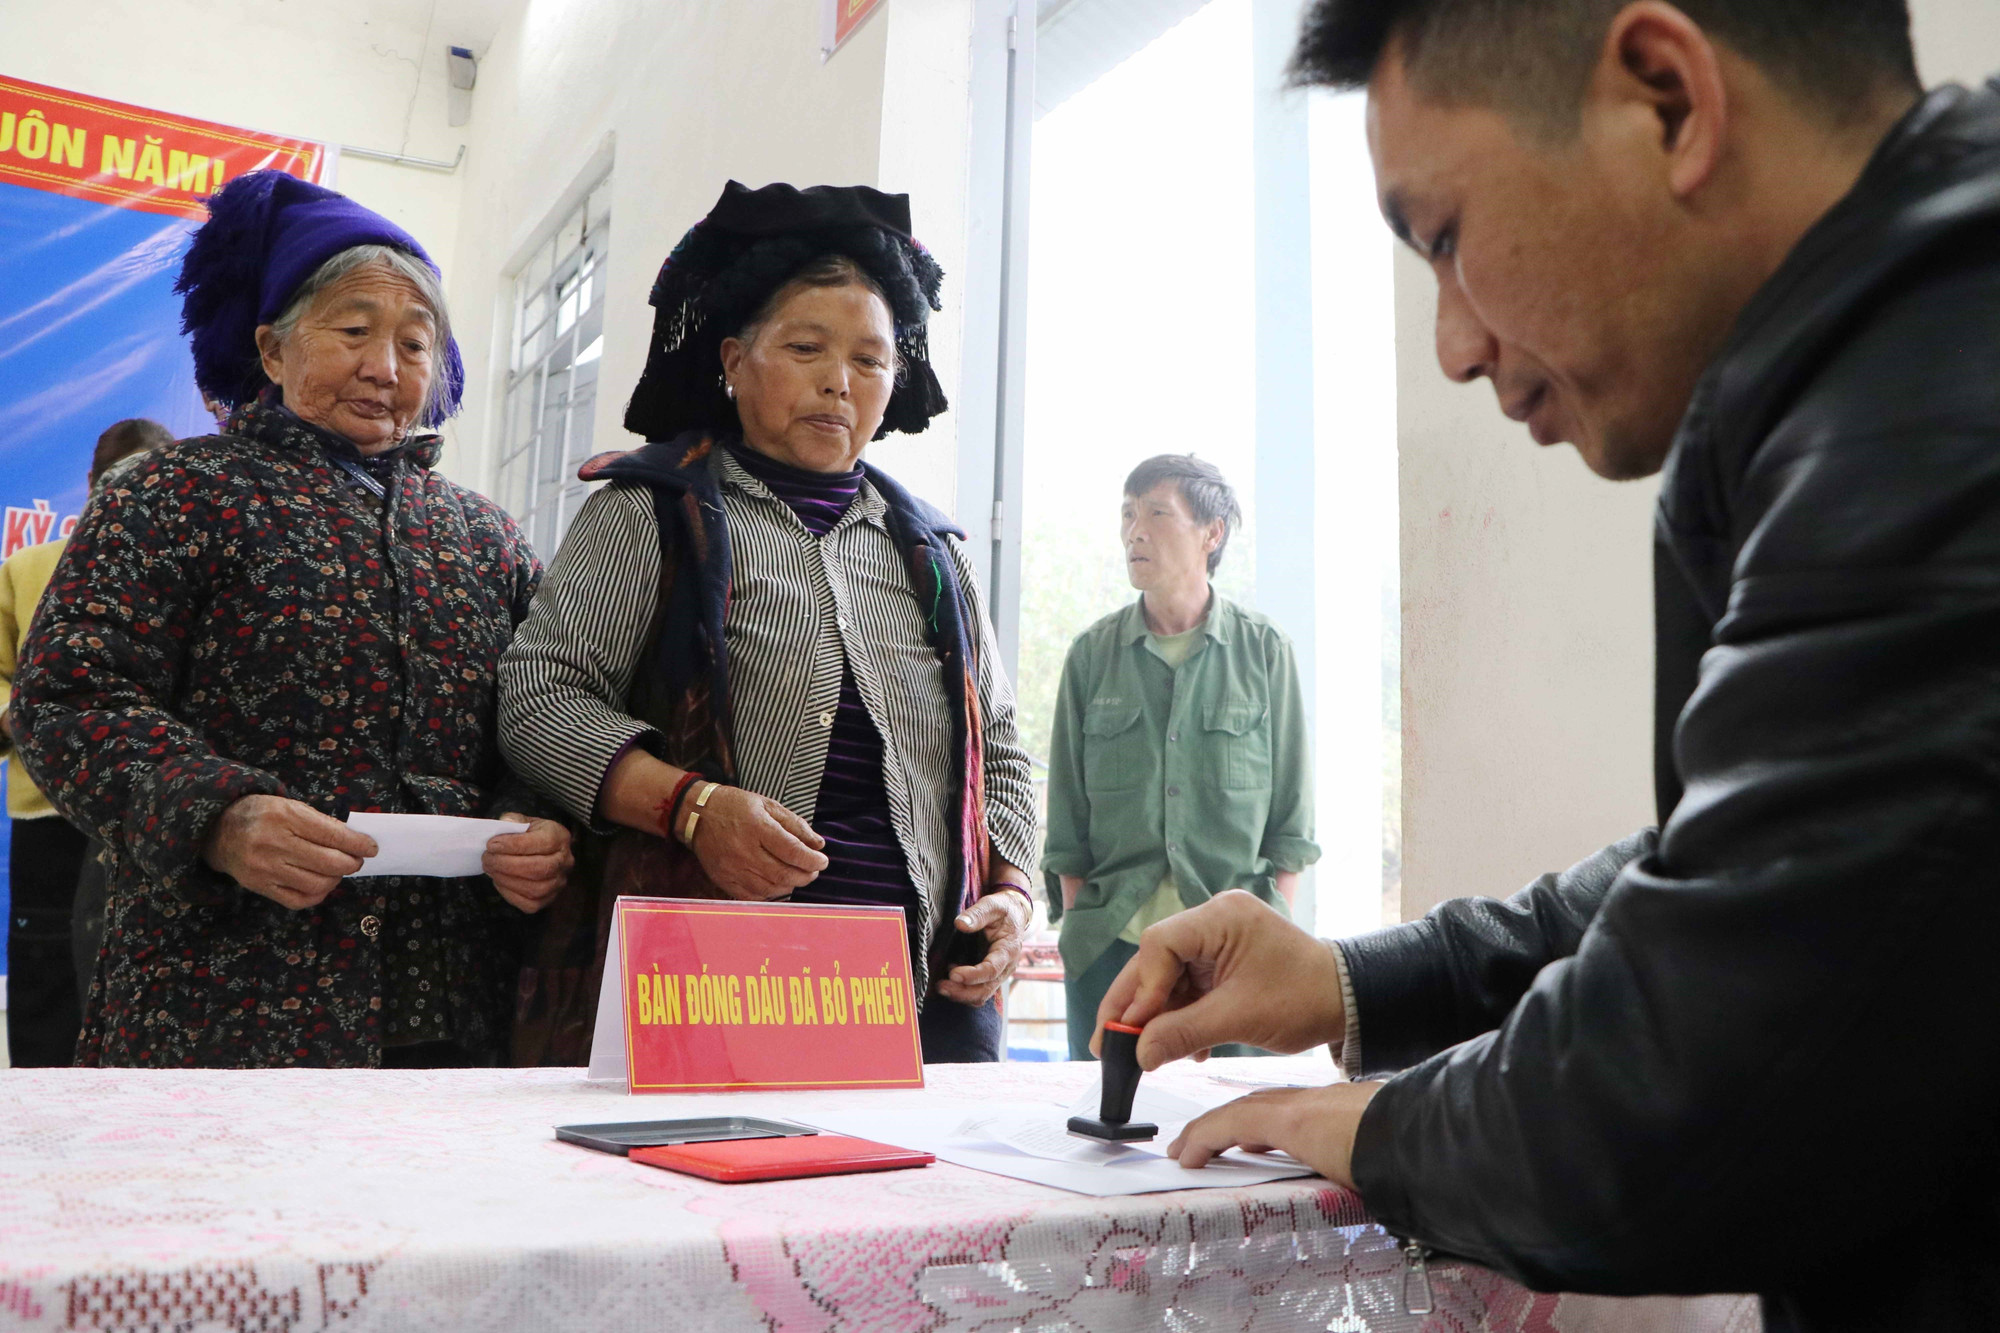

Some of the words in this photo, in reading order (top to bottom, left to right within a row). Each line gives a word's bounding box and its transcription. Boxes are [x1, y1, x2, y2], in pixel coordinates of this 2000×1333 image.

[100, 134, 225, 196] NĂM!
[2, 499, 57, 560] KỲ
[637, 963, 682, 1025] BÀN
[686, 964, 743, 1026] ĐÓNG
[745, 958, 786, 1026] DẤU
[789, 967, 818, 1025] ĐÃ
[820, 960, 848, 1025] BỎ
[850, 962, 906, 1026] PHIẾU
